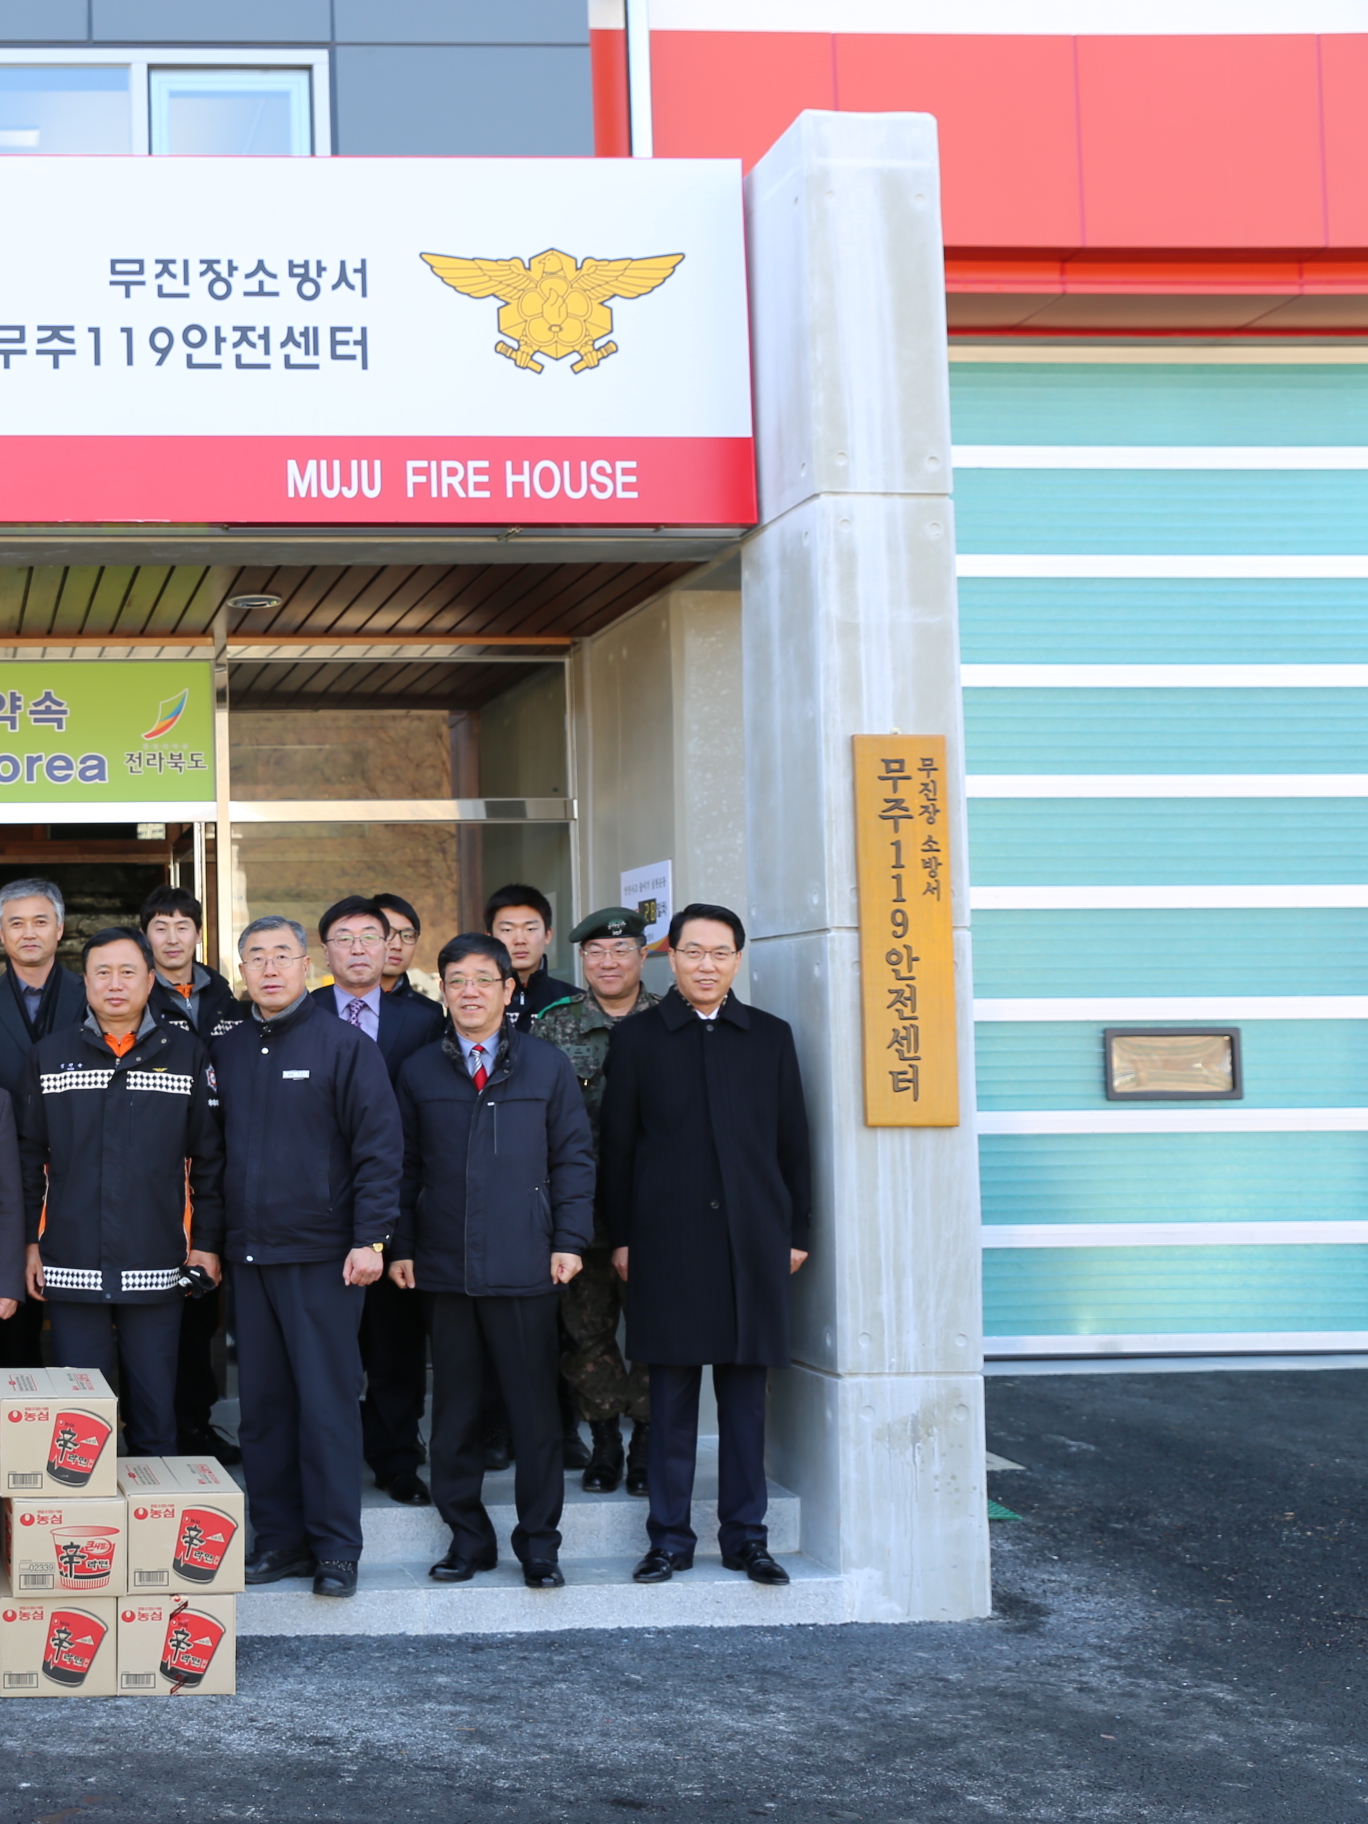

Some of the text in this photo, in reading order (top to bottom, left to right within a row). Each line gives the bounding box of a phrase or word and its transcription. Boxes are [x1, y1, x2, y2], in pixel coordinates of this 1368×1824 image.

[110, 259, 368, 301] 무진장소방서
[287, 460, 639, 499] MUJU FIRE HOUSE
[125, 751, 207, 774] 전라북도
[917, 757, 943, 902] 무진장 소방서
[877, 758, 921, 1102] 무주119안전센터
[24, 1411, 49, 1421] 농심
[56, 1427, 80, 1462] 辛
[37, 1514, 62, 1525] 농심
[151, 1508, 175, 1519] 농심
[182, 1524, 206, 1559] 辛
[60, 1542, 87, 1578] 辛
[87, 1560, 110, 1569] 라면
[19, 1611, 44, 1621] 농심
[138, 1611, 162, 1621] 농심
[51, 1627, 74, 1661] 辛
[170, 1628, 192, 1661] 辛
